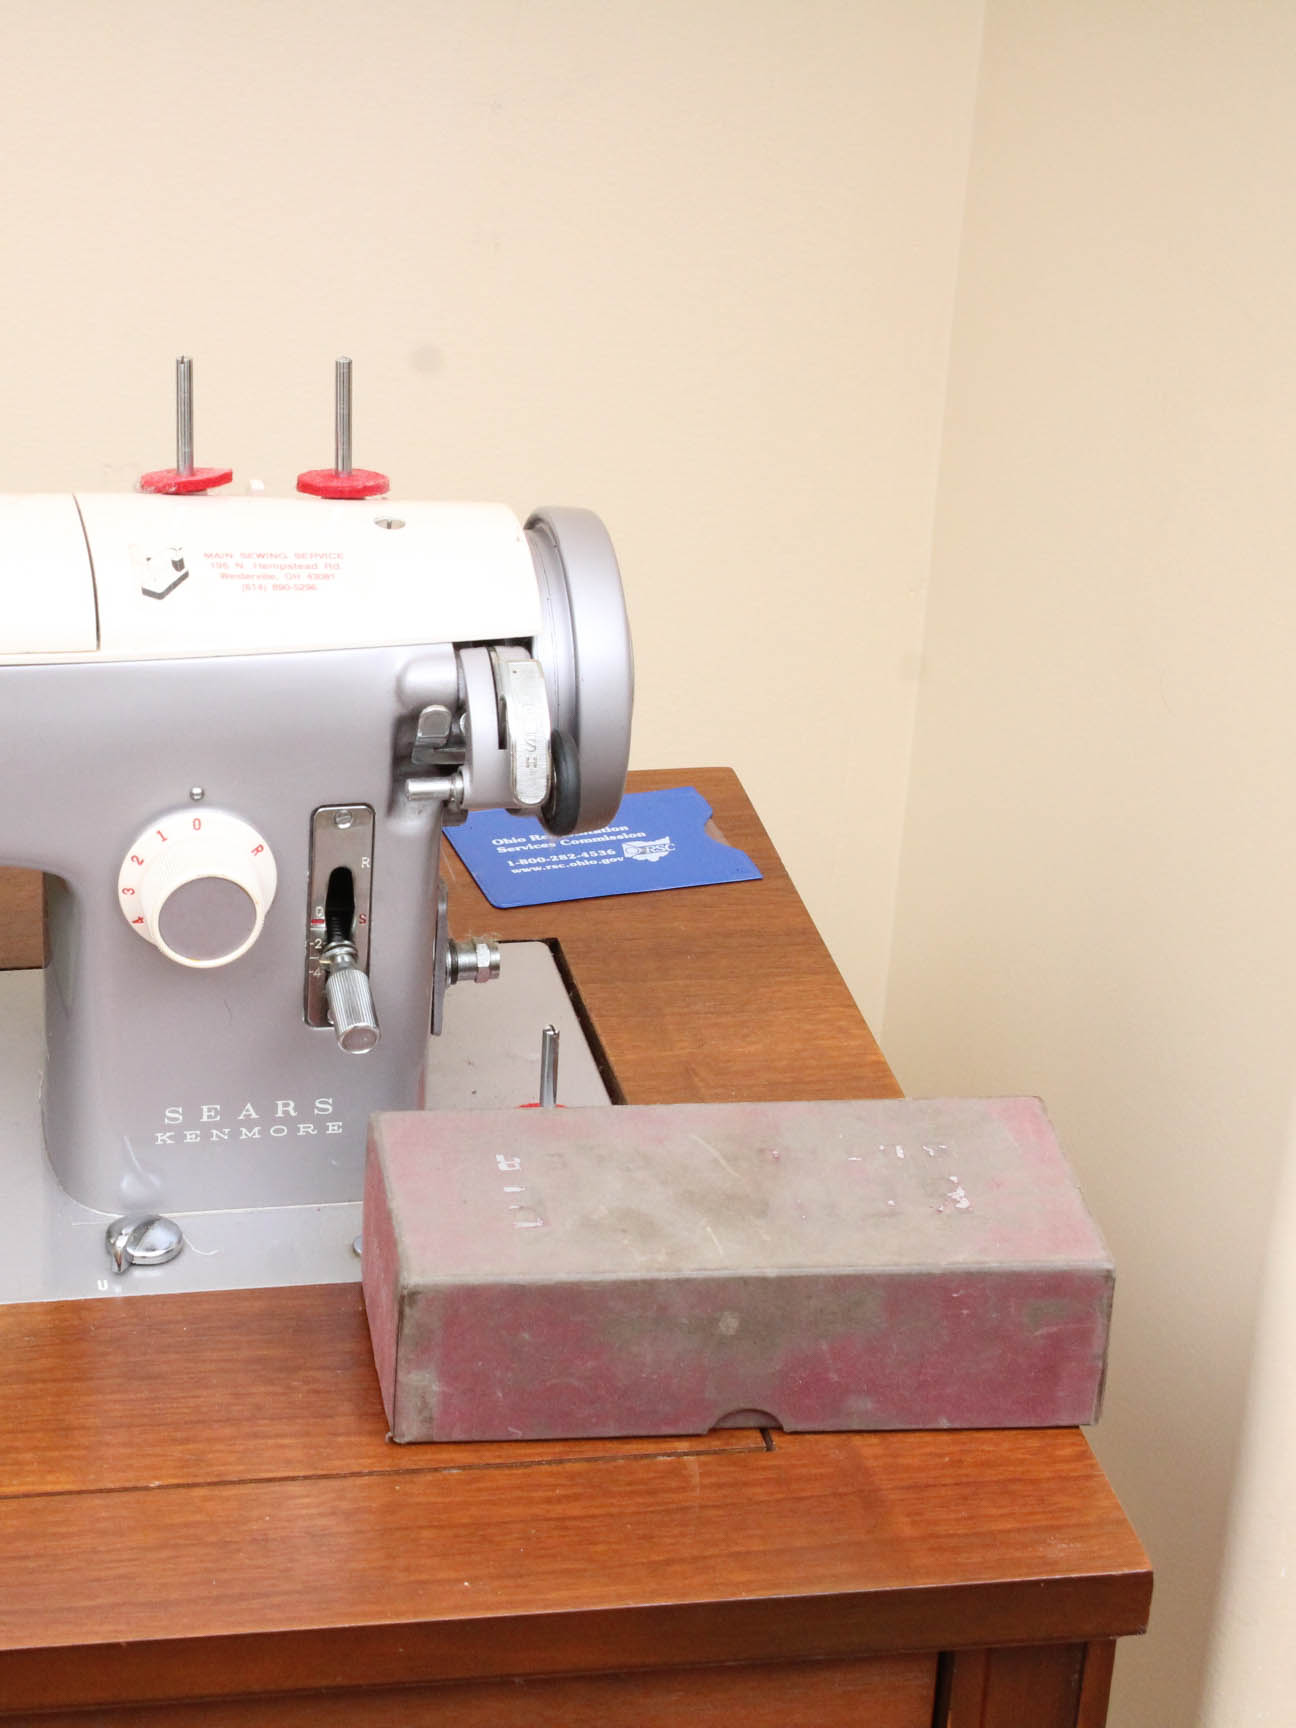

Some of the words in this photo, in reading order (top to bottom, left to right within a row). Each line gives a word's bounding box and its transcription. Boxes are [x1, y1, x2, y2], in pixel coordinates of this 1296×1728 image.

[203, 552, 233, 560] MAIN
[240, 552, 288, 560] SEWING
[294, 552, 344, 560] SERVICE
[492, 837, 527, 846] Ohio
[496, 842, 557, 854] Services
[560, 832, 647, 846] Commission
[646, 842, 676, 855] RSC
[122, 886, 136, 896] 3
[131, 855, 145, 866] 2
[156, 830, 168, 842] 1
[192, 818, 202, 831] 0
[251, 844, 264, 856] R
[361, 857, 371, 868] R
[507, 849, 617, 867] 1-800-282-4536
[511, 856, 625, 874] www.rsc.ohio.gov
[358, 914, 368, 925] S
[164, 1097, 334, 1125] SEARS
[155, 1121, 344, 1145] KENMORE
